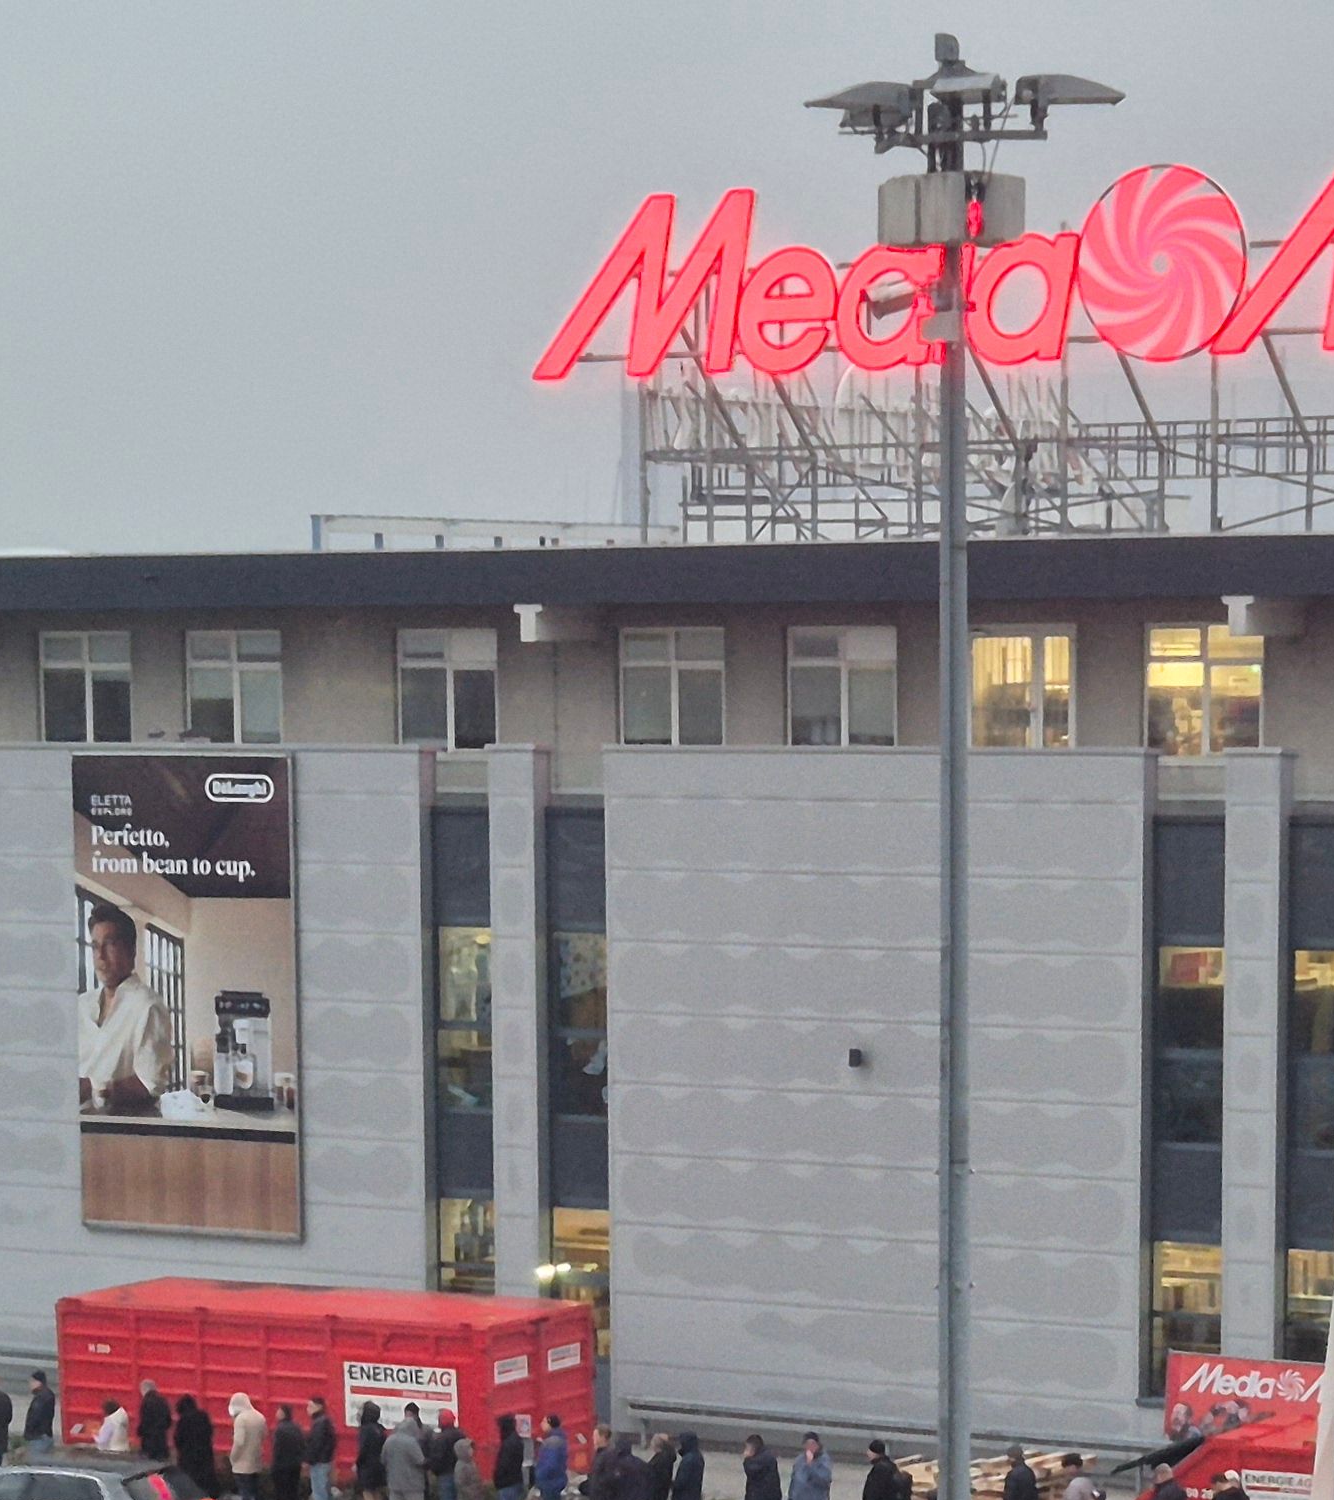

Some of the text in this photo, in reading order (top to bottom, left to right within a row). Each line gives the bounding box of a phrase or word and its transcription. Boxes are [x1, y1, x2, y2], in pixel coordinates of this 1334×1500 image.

[531, 186, 1080, 381] Media
[91, 794, 133, 807] ELETTA
[91, 823, 170, 848] Perfetto,
[91, 851, 256, 883] from bean to cup.
[347, 1364, 452, 1387] ENERGIE AG
[1179, 1362, 1277, 1400] Media
[1244, 1474, 1296, 1488] ENERGIE
